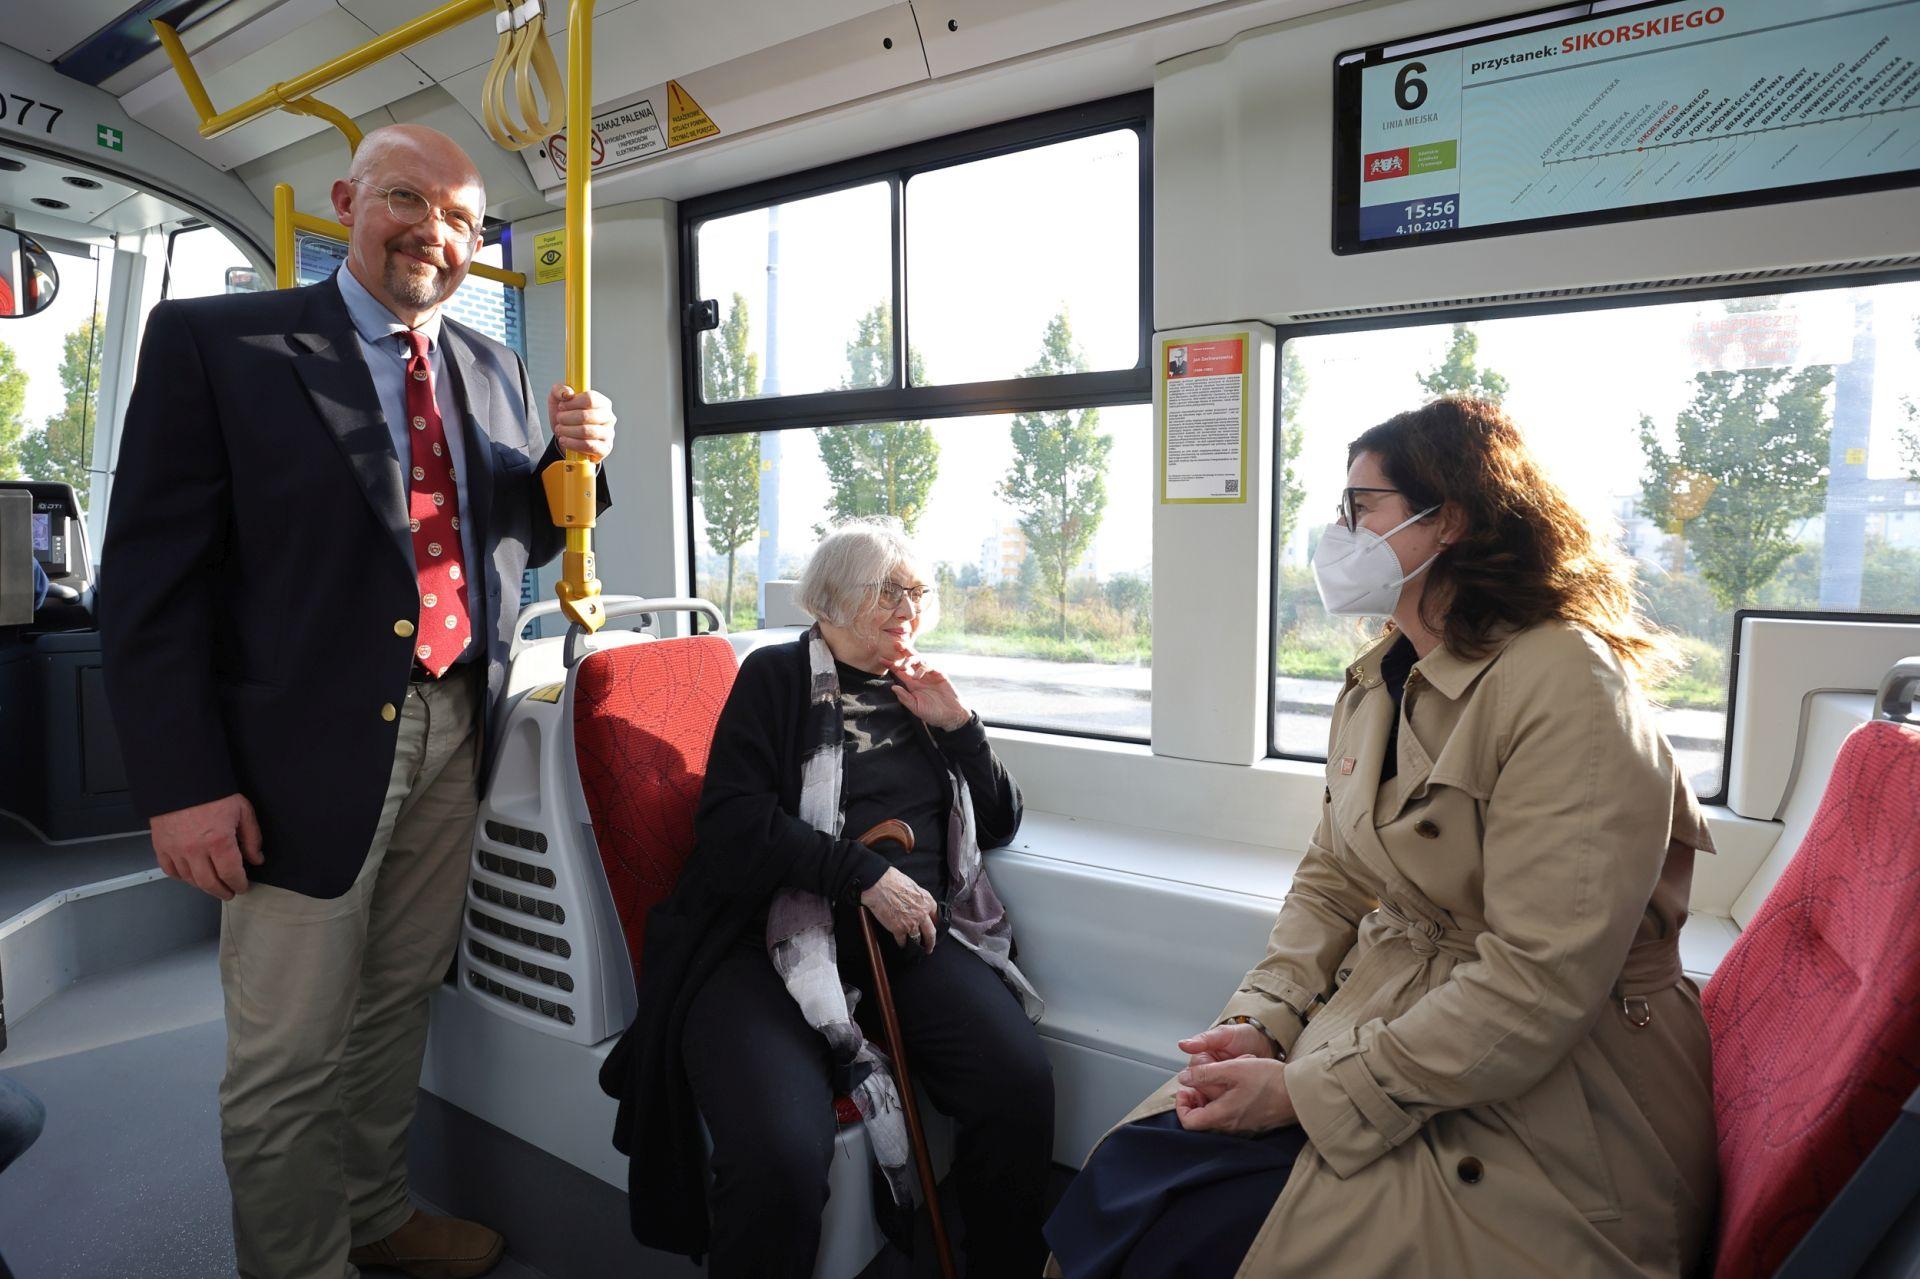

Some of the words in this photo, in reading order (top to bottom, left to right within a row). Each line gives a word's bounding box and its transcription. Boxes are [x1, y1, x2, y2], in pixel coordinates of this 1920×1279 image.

[1471, 45, 1557, 74] przystanek:
[1561, 6, 1725, 54] SIKORSKIEGO
[1394, 61, 1428, 111] 6
[1749, 76, 1767, 93] SKM
[1761, 101, 1788, 125] BRAMA
[1786, 71, 1820, 101] OLIWSKA
[1780, 62, 1846, 122] CHODOWIECKIEGO
[1799, 72, 1850, 119] UNIWERSYTET
[1818, 76, 1864, 116] TRAUGUTTA
[0, 92, 63, 134] 77
[595, 113, 621, 132] ZAKAZ
[620, 107, 653, 126] PALENIA
[1383, 118, 1403, 131] LINIA
[1404, 113, 1439, 128] MIEJSKA
[1588, 111, 1631, 152] WILANOWSKA
[1637, 104, 1679, 144] SIKORSKIEGO
[1689, 97, 1731, 137] POHULANKA
[1724, 107, 1750, 131] BRAMA
[1396, 218, 1454, 235] 4.10.2021
[1405, 200, 1455, 220] 15:56
